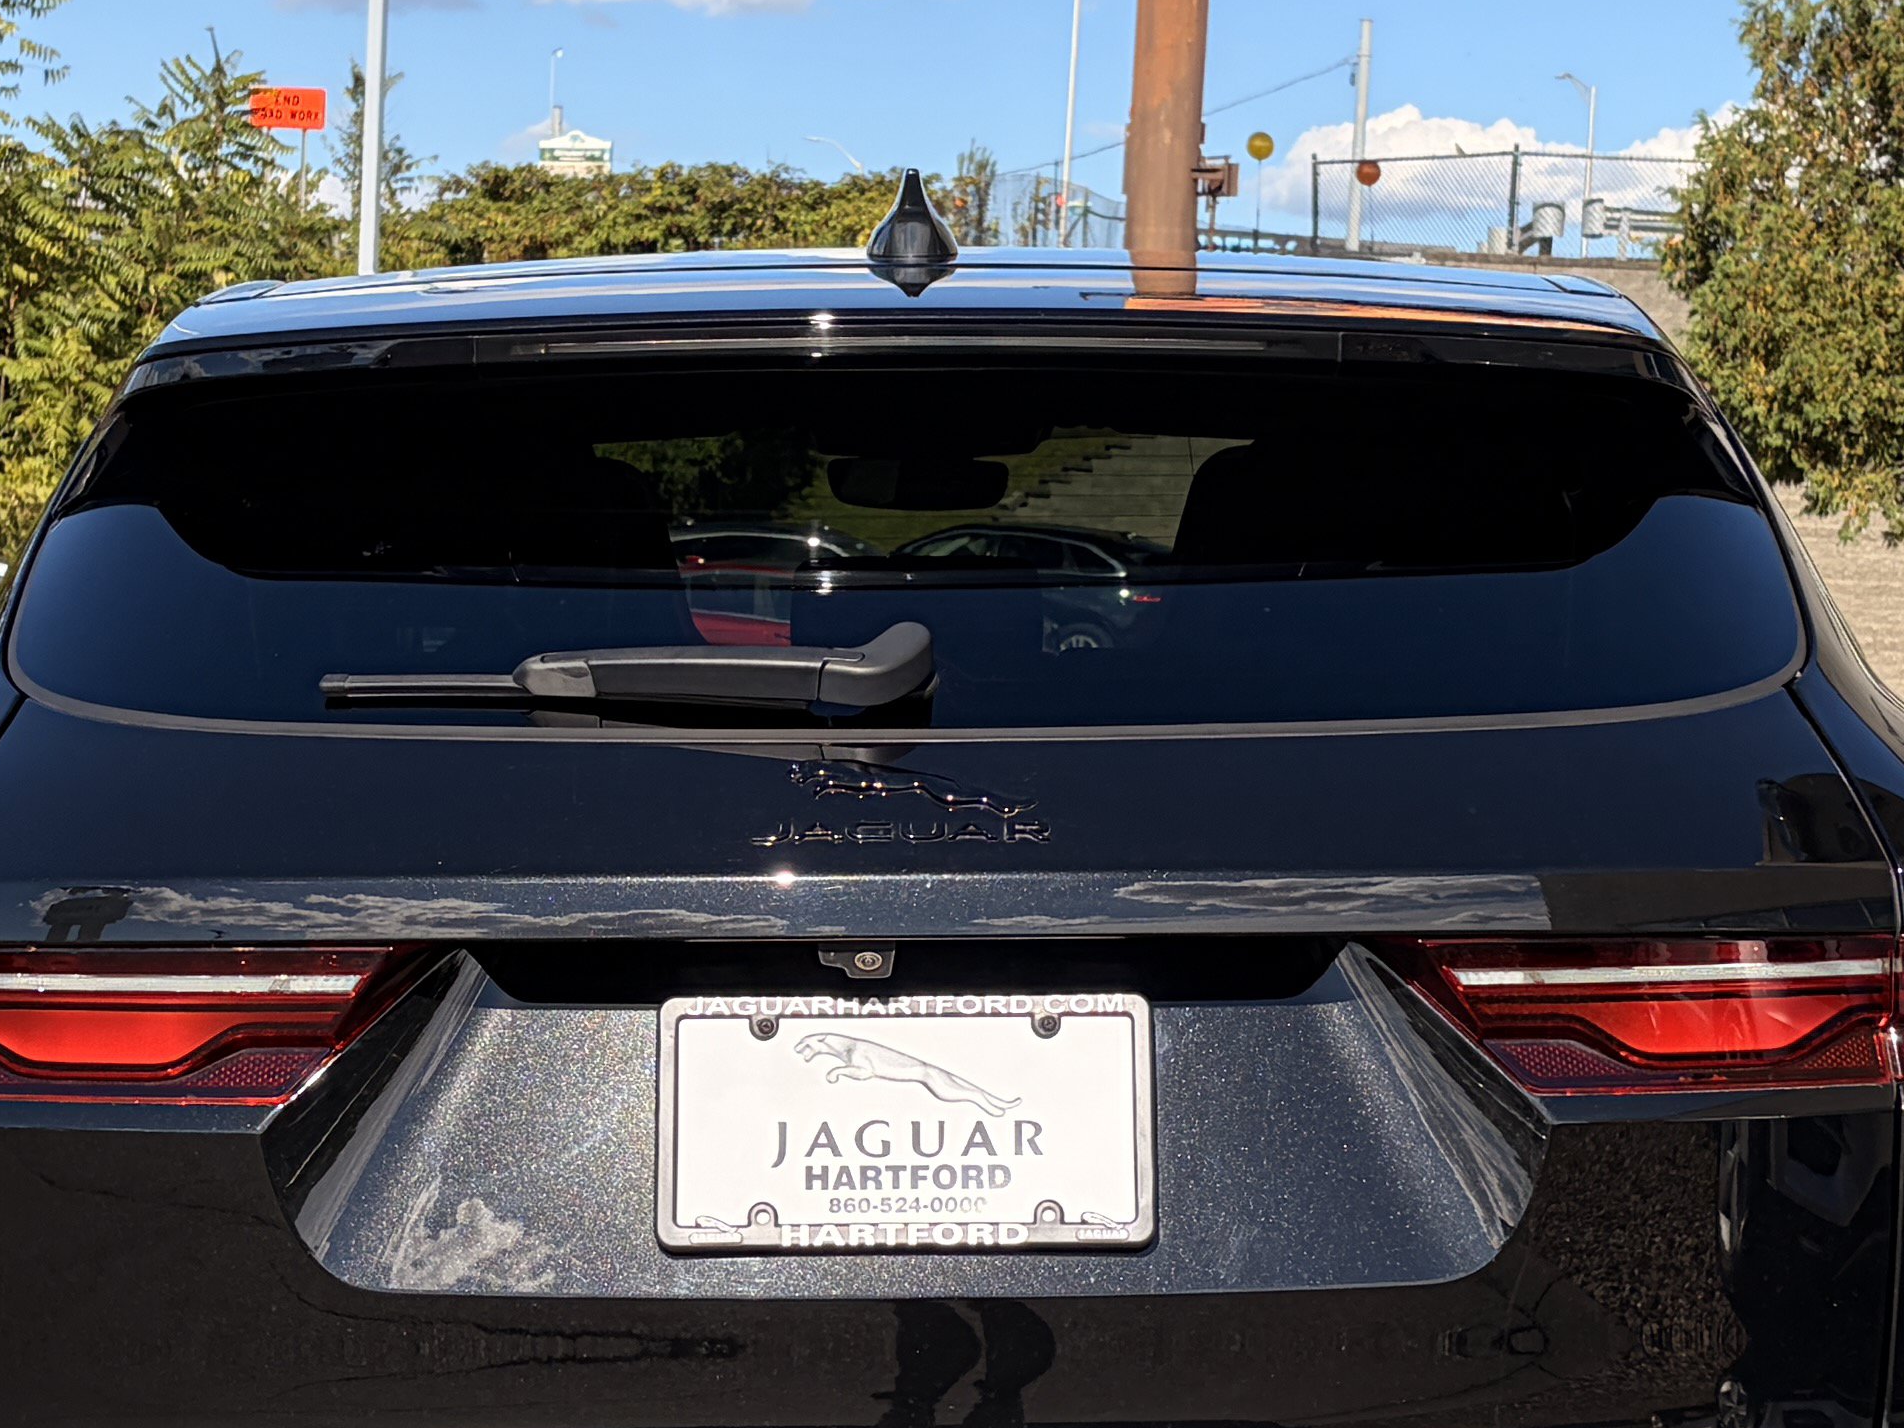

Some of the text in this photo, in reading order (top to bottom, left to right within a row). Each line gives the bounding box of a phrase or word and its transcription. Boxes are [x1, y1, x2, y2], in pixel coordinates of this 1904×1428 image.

[289, 109, 320, 122] WORK
[750, 820, 1052, 846] JAGUAR
[770, 1119, 1044, 1169] JAGUAR
[804, 1163, 1012, 1191] HARTFORD
[780, 1223, 1030, 1247] HARTFORD
